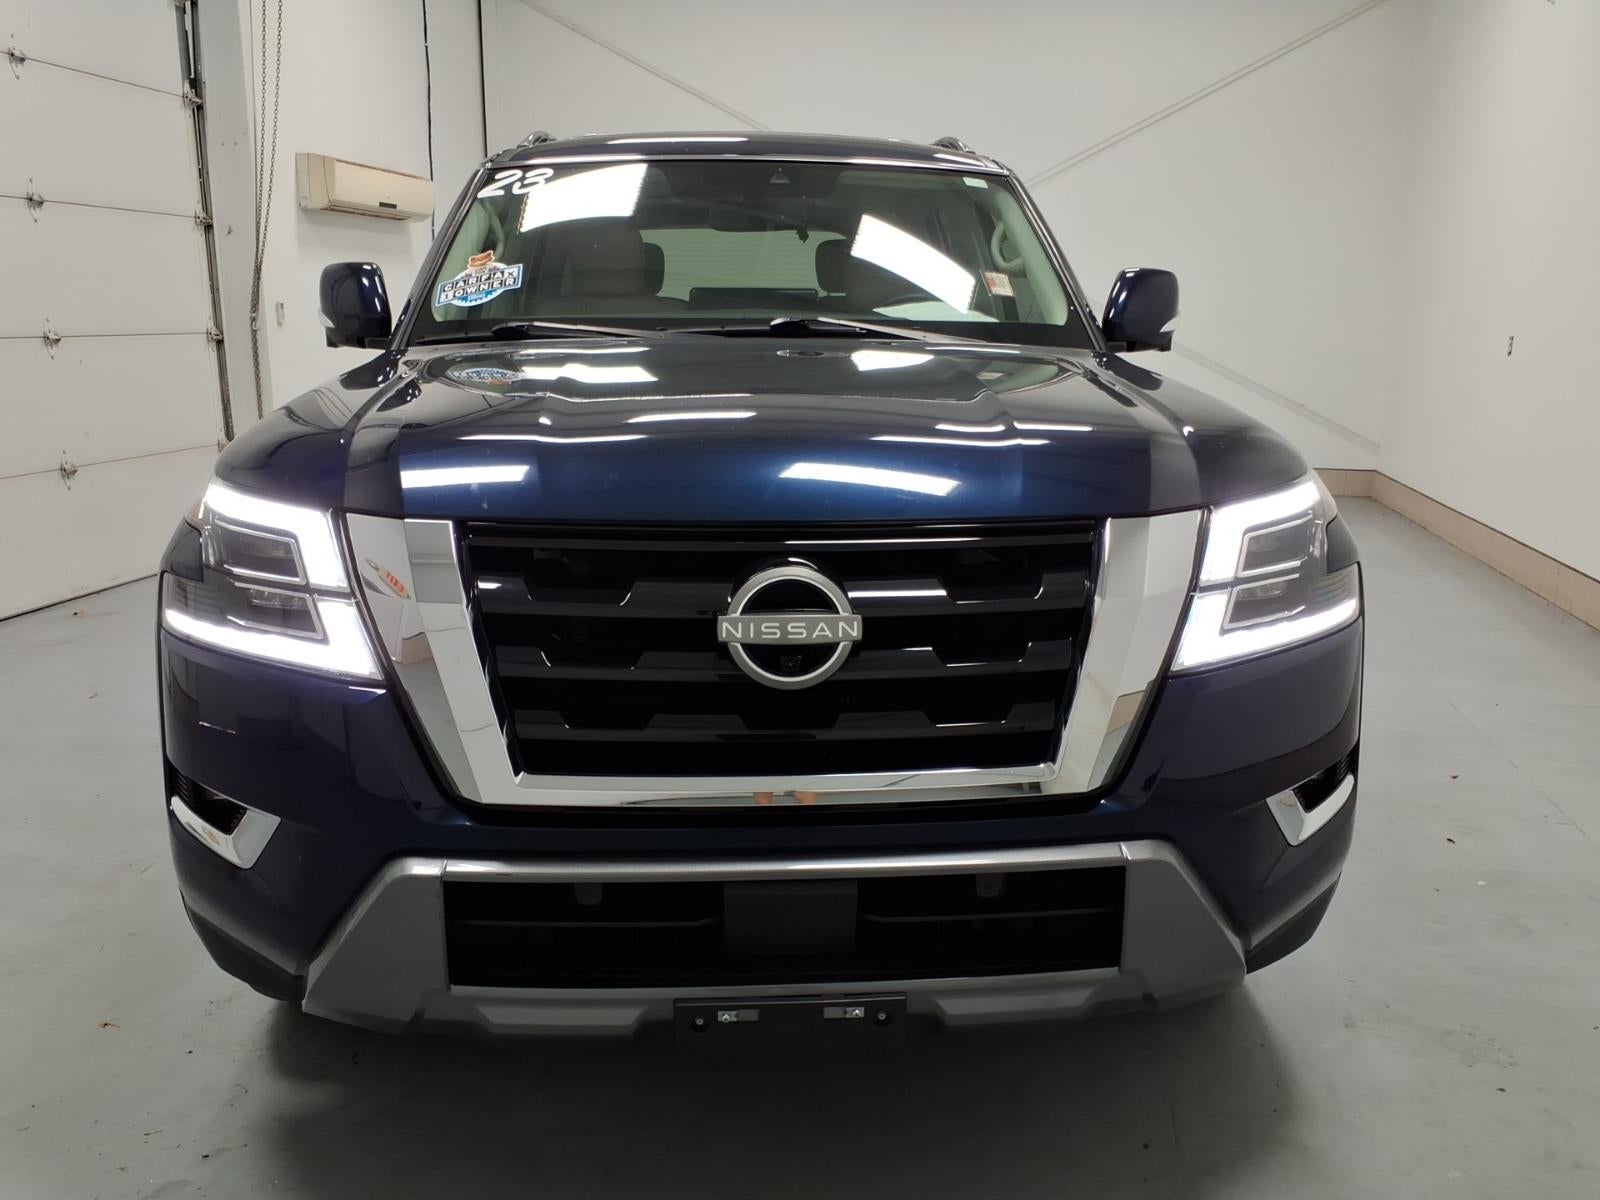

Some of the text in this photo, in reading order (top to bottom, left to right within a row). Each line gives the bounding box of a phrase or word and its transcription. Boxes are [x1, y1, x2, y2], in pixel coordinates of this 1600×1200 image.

[478, 168, 554, 198] 23
[444, 271, 515, 291] CARFAX
[454, 278, 515, 296] OWNER
[722, 621, 858, 638] NISSAN
